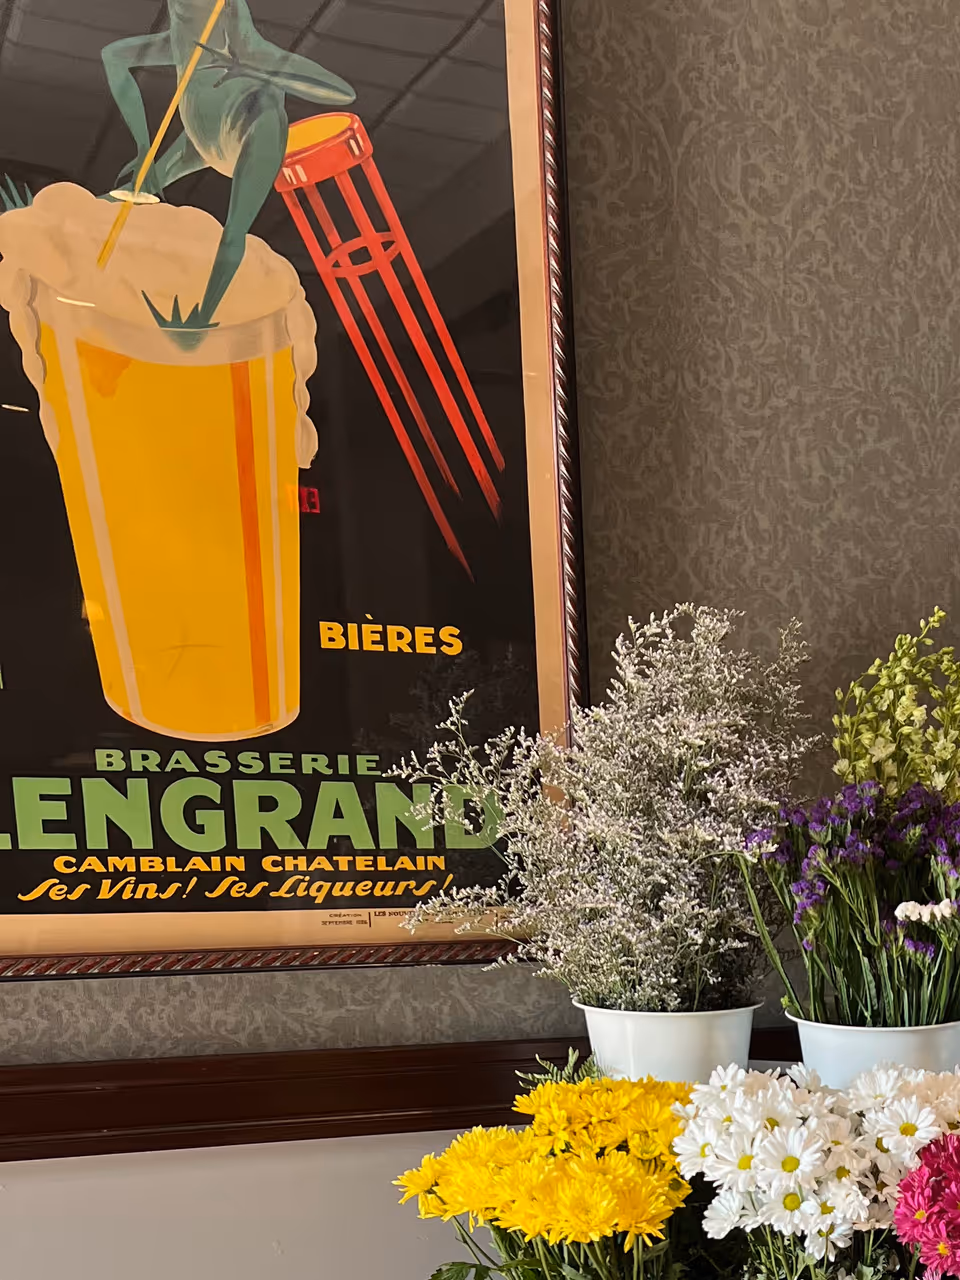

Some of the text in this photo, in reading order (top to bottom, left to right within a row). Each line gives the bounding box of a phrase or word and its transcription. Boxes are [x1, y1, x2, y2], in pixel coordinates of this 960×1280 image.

[319, 613, 463, 655] BIÈRES
[95, 749, 381, 776] BRASSERIE
[53, 855, 446, 873] CAMBLAIN CHATELAIN
[17, 873, 454, 904] Ses Vins! Ses Liqueurs!
